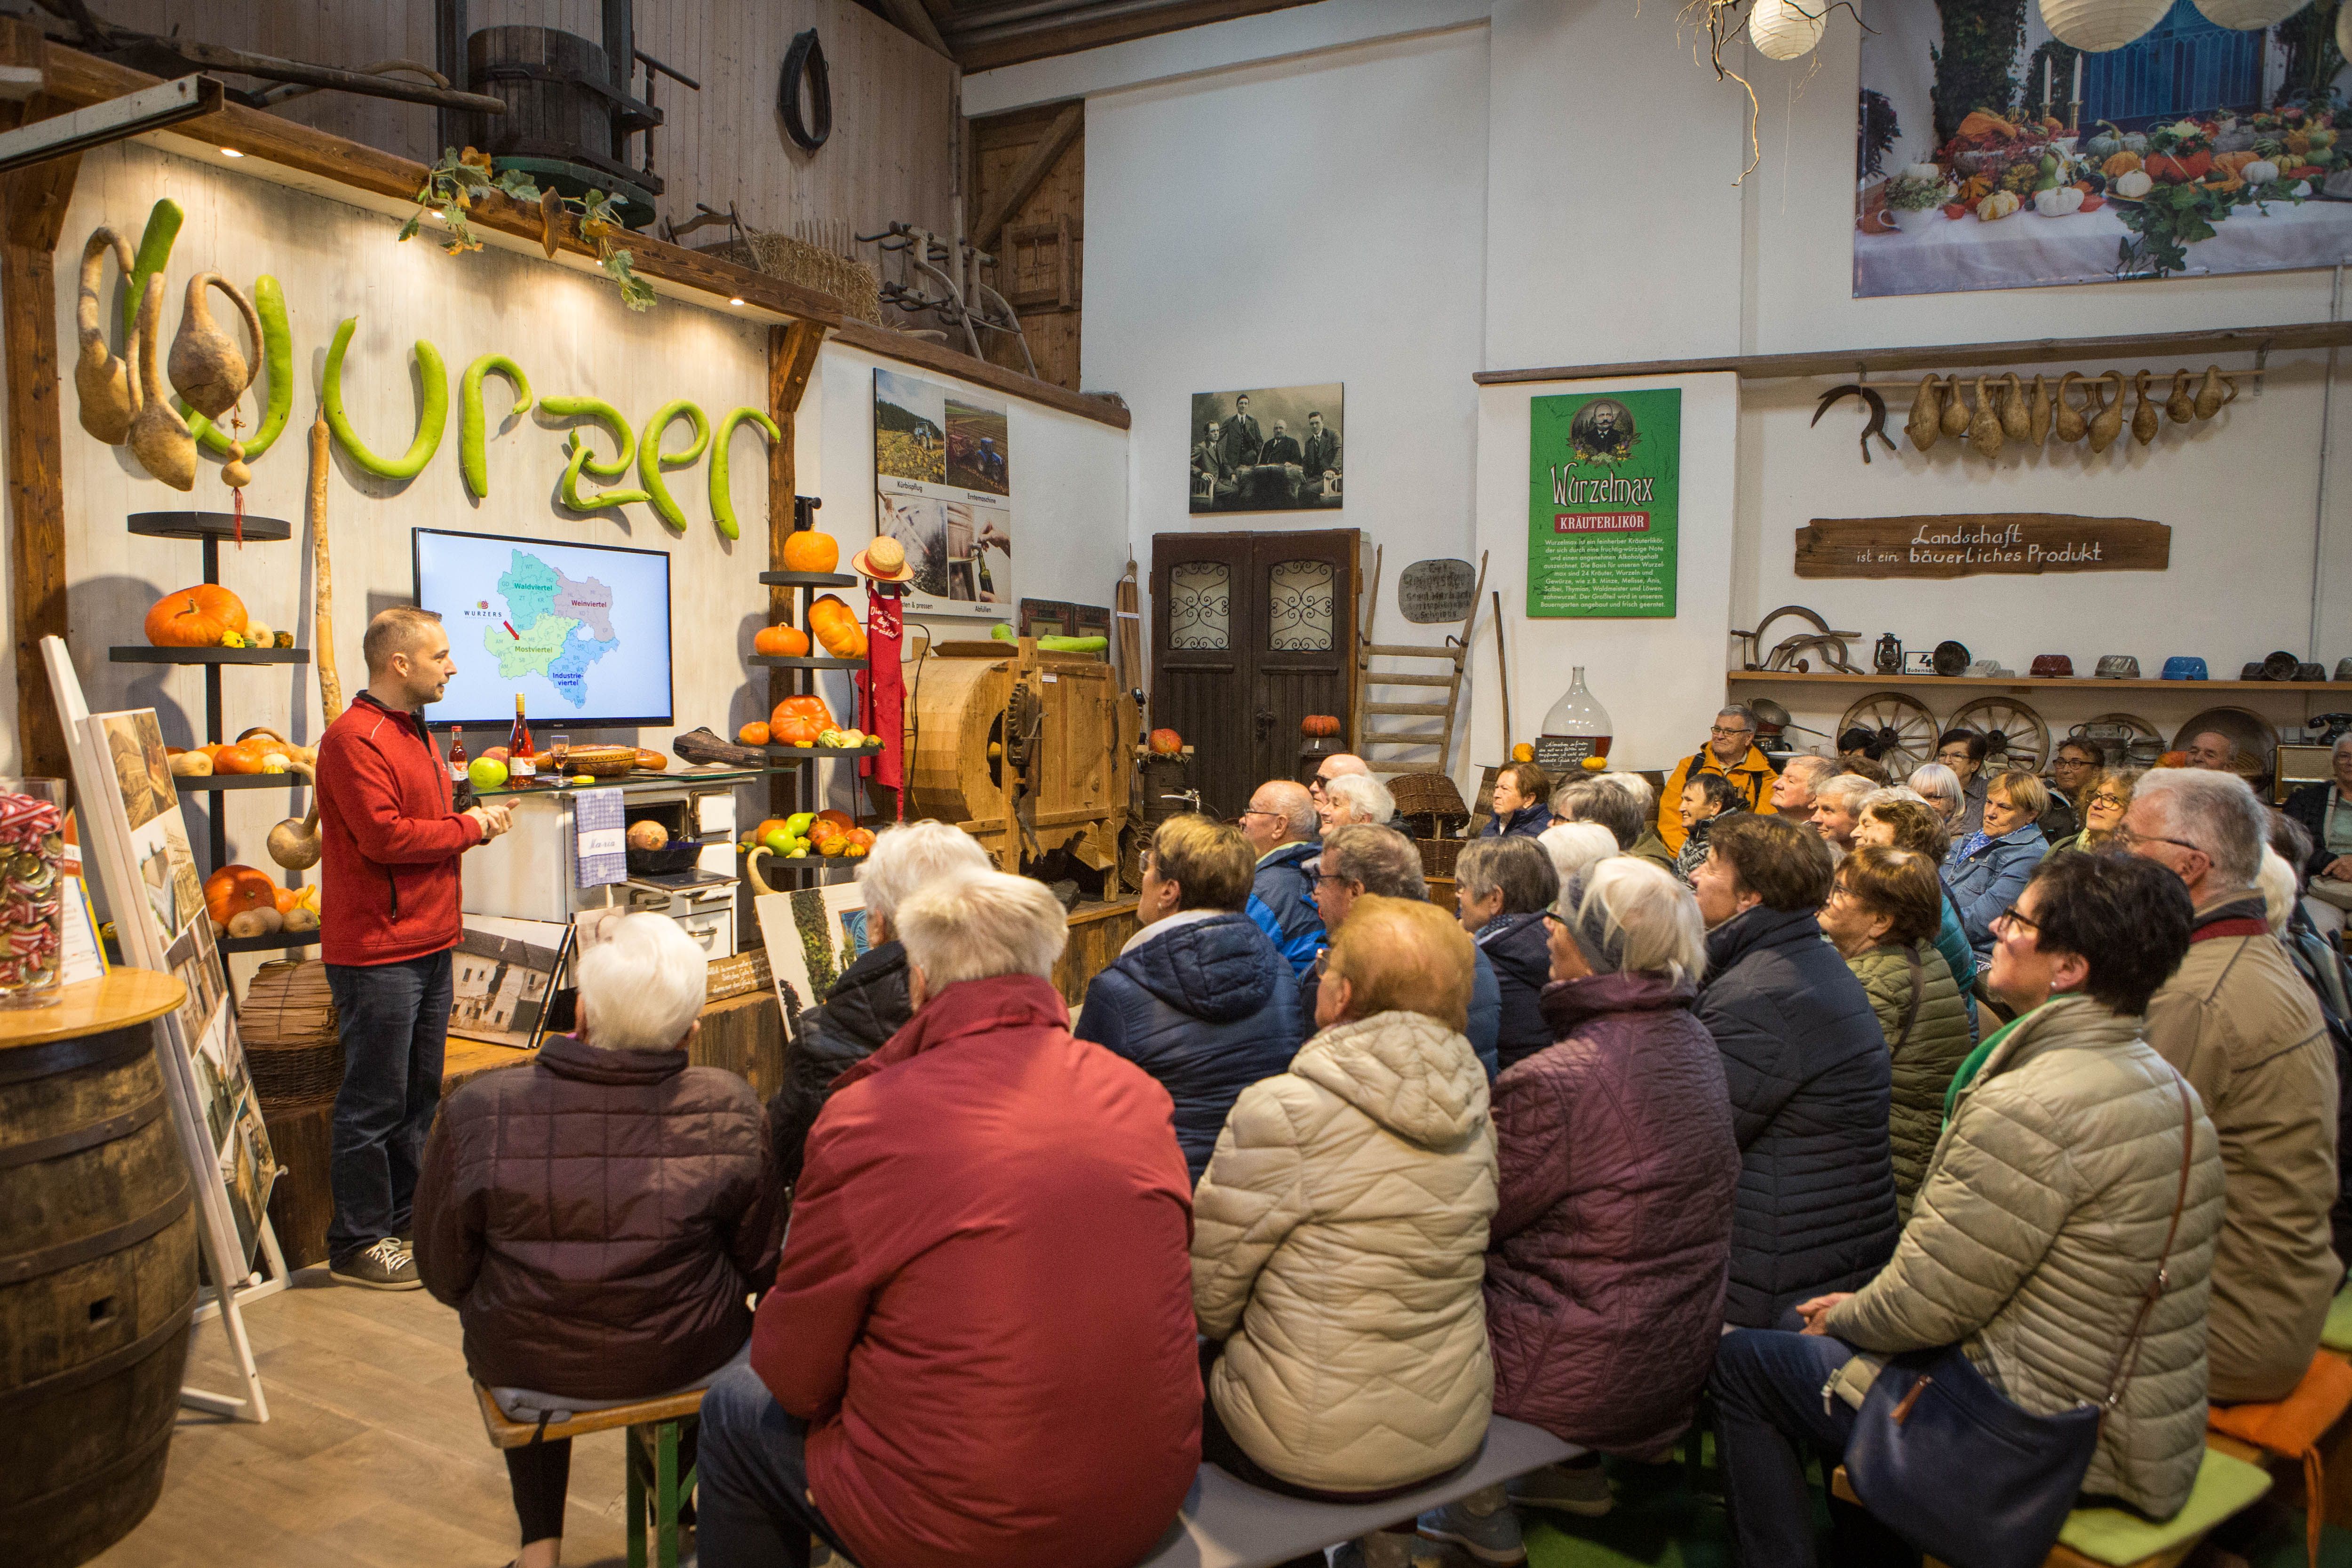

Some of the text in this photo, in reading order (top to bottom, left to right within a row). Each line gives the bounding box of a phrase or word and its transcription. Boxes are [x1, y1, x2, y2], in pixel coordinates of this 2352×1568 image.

[897, 481, 922, 493] Kürbispflug
[1550, 462, 1655, 507] Wurzelmax
[967, 493, 996, 504] Erntemaschine
[1560, 514, 1644, 529] KRÄUTERLIKÖR
[1911, 524, 2022, 548] Landschaft
[1857, 549, 1872, 562] ist
[1878, 552, 1899, 562] ein
[2027, 542, 2103, 562] Produkt
